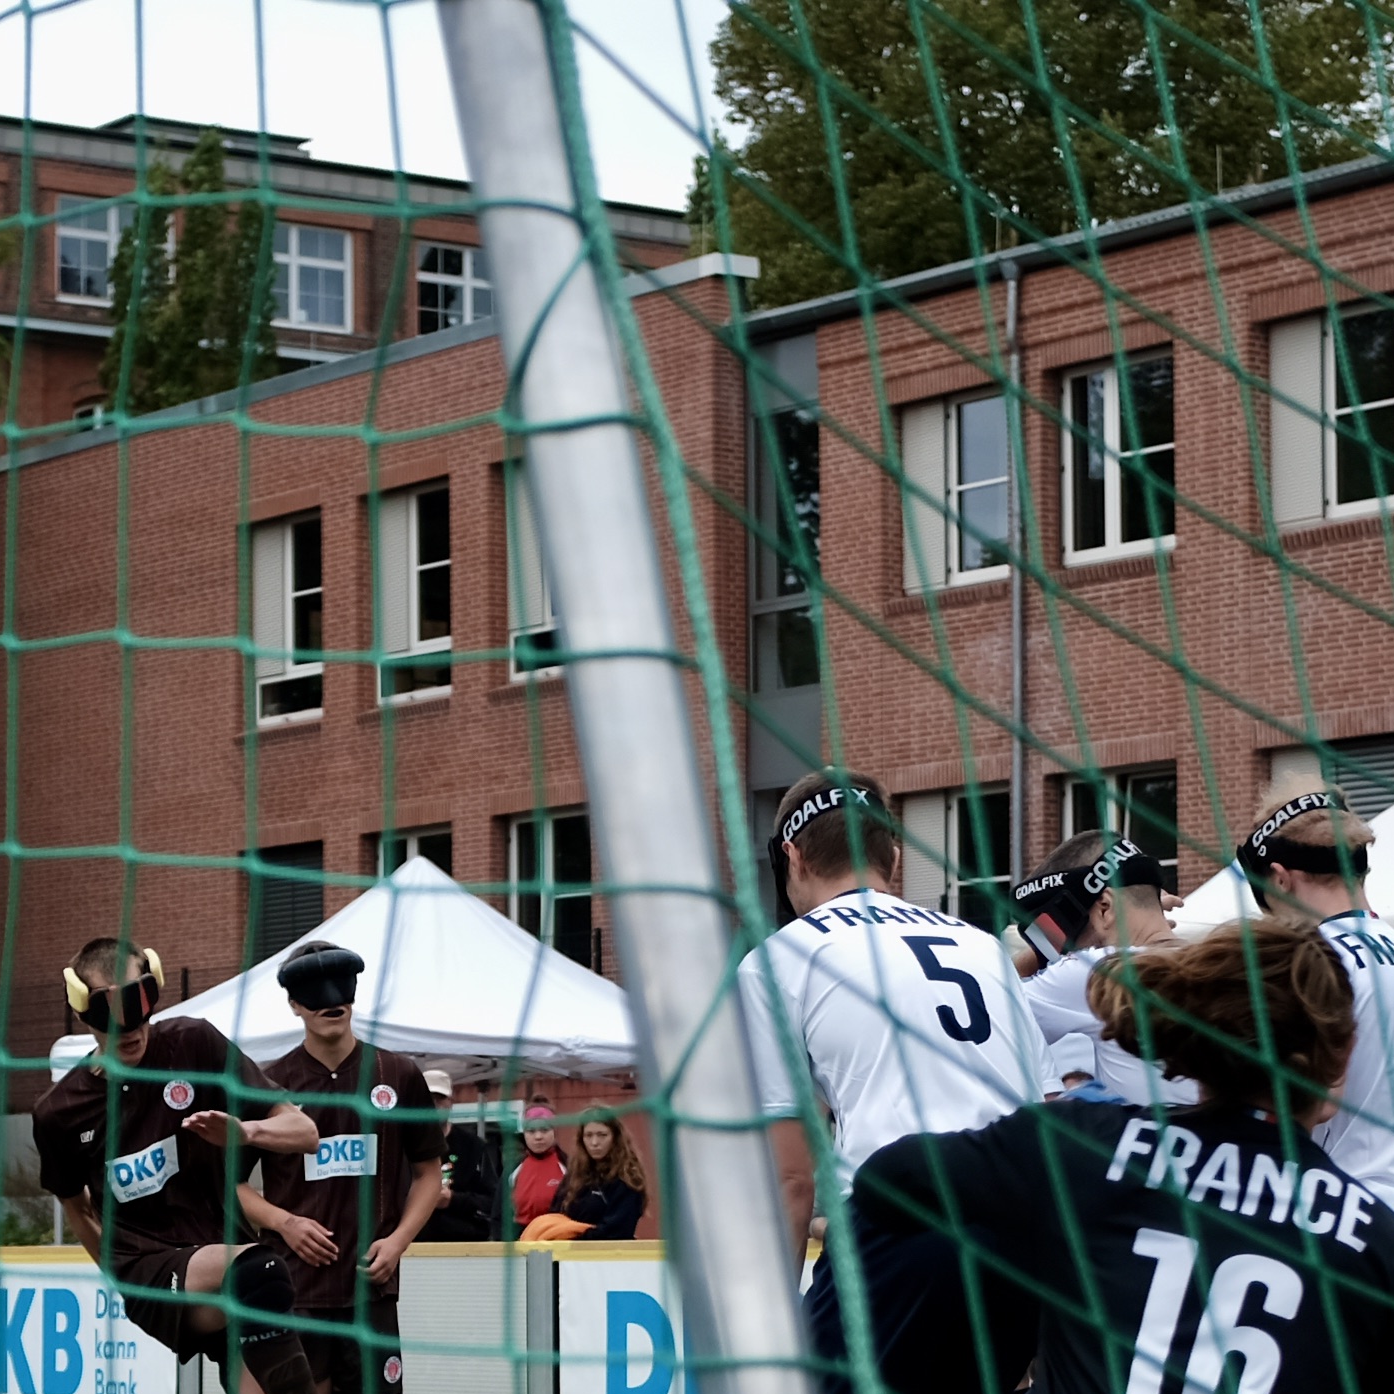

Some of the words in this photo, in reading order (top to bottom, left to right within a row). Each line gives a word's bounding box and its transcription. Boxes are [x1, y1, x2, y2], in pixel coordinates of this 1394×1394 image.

[1252, 793, 1336, 848] GOALFIX
[802, 905, 967, 934] FRANC
[900, 935, 991, 1045] 5
[114, 1147, 167, 1188] DKB
[316, 1139, 365, 1165] DKB
[1106, 1117, 1375, 1252] FRANCE
[95, 1329, 137, 1360] kann
